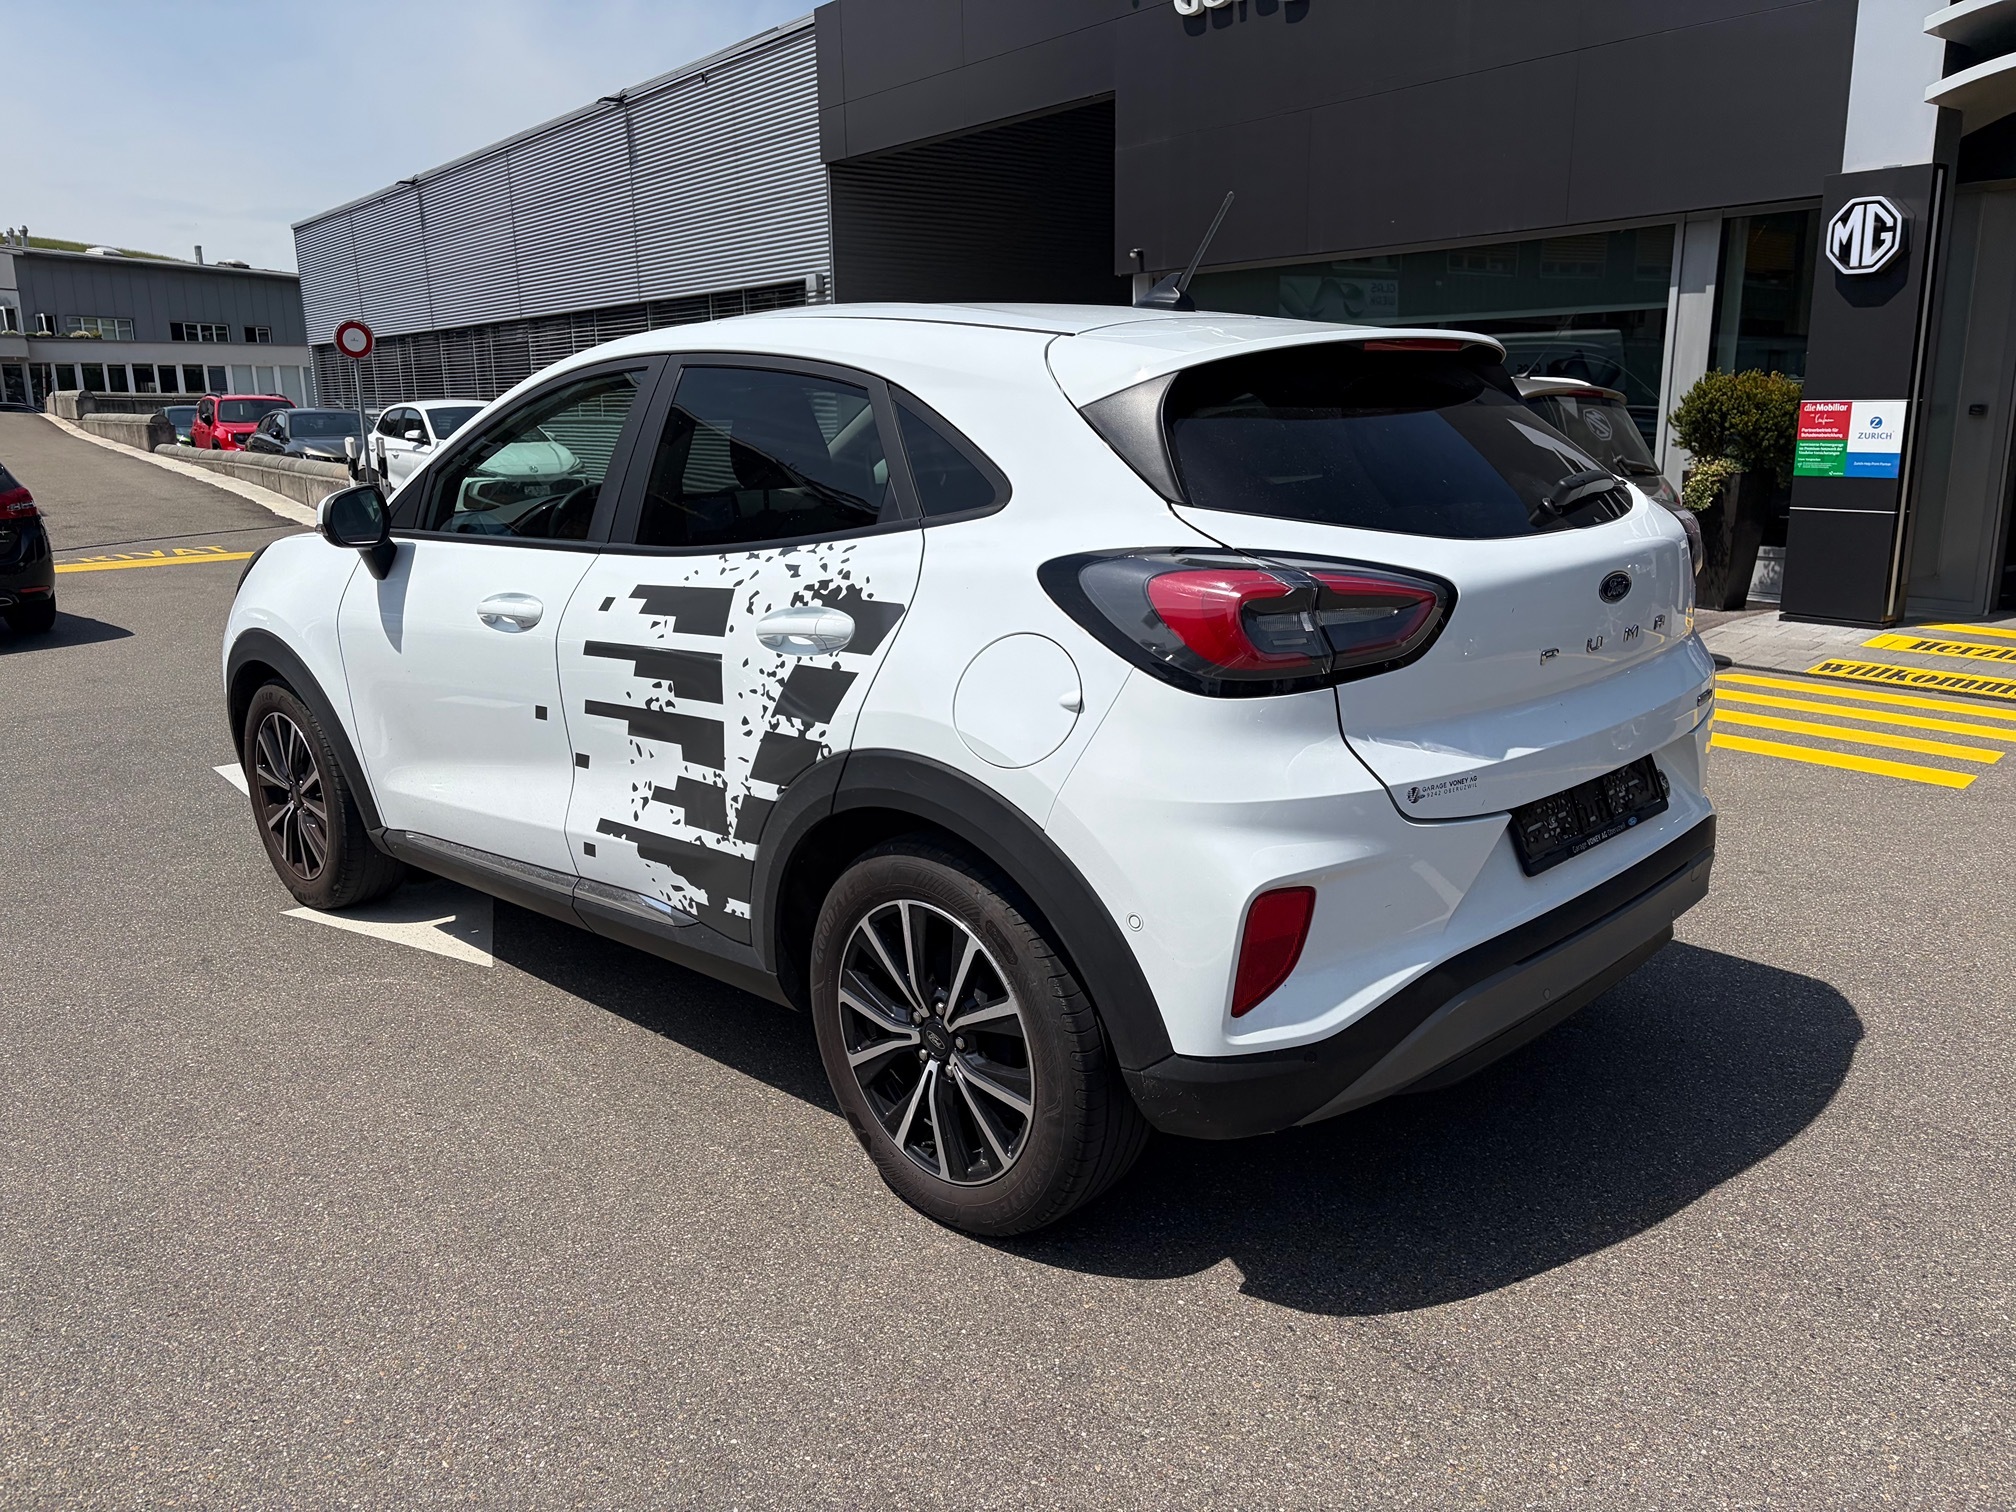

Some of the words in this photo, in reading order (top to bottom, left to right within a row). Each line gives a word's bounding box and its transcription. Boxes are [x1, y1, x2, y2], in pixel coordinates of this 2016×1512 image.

[1831, 202, 1894, 267] MG
[1858, 432, 1892, 440] ZURICH
[1818, 662, 2016, 694] willkomm
[1422, 782, 1447, 792] GARAGE
[1449, 777, 1469, 787] VONEY
[1427, 790, 1441, 798] 9242
[1444, 783, 1477, 794] OBERUZWIL
[1586, 834, 1601, 846] VONEY
